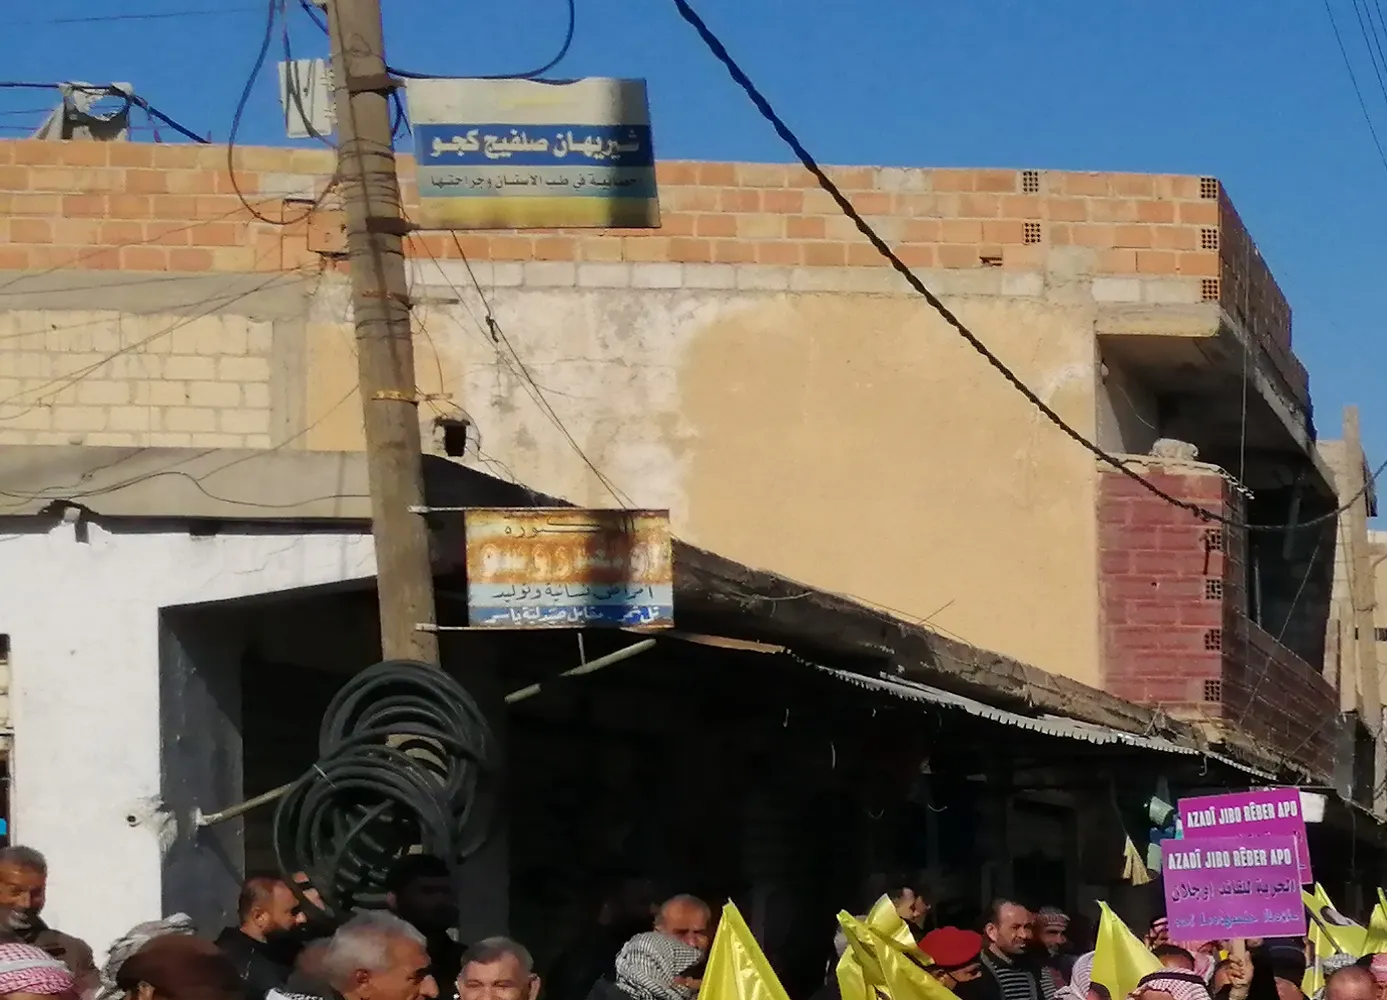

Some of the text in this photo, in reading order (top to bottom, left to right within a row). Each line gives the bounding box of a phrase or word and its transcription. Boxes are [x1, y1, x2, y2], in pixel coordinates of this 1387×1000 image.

[573, 174, 586, 188] في
[1187, 800, 1298, 828] AZADÎ JIBO RÊBER APO
[1168, 846, 1292, 870] AZADÎ JIBO RÊBER APO
